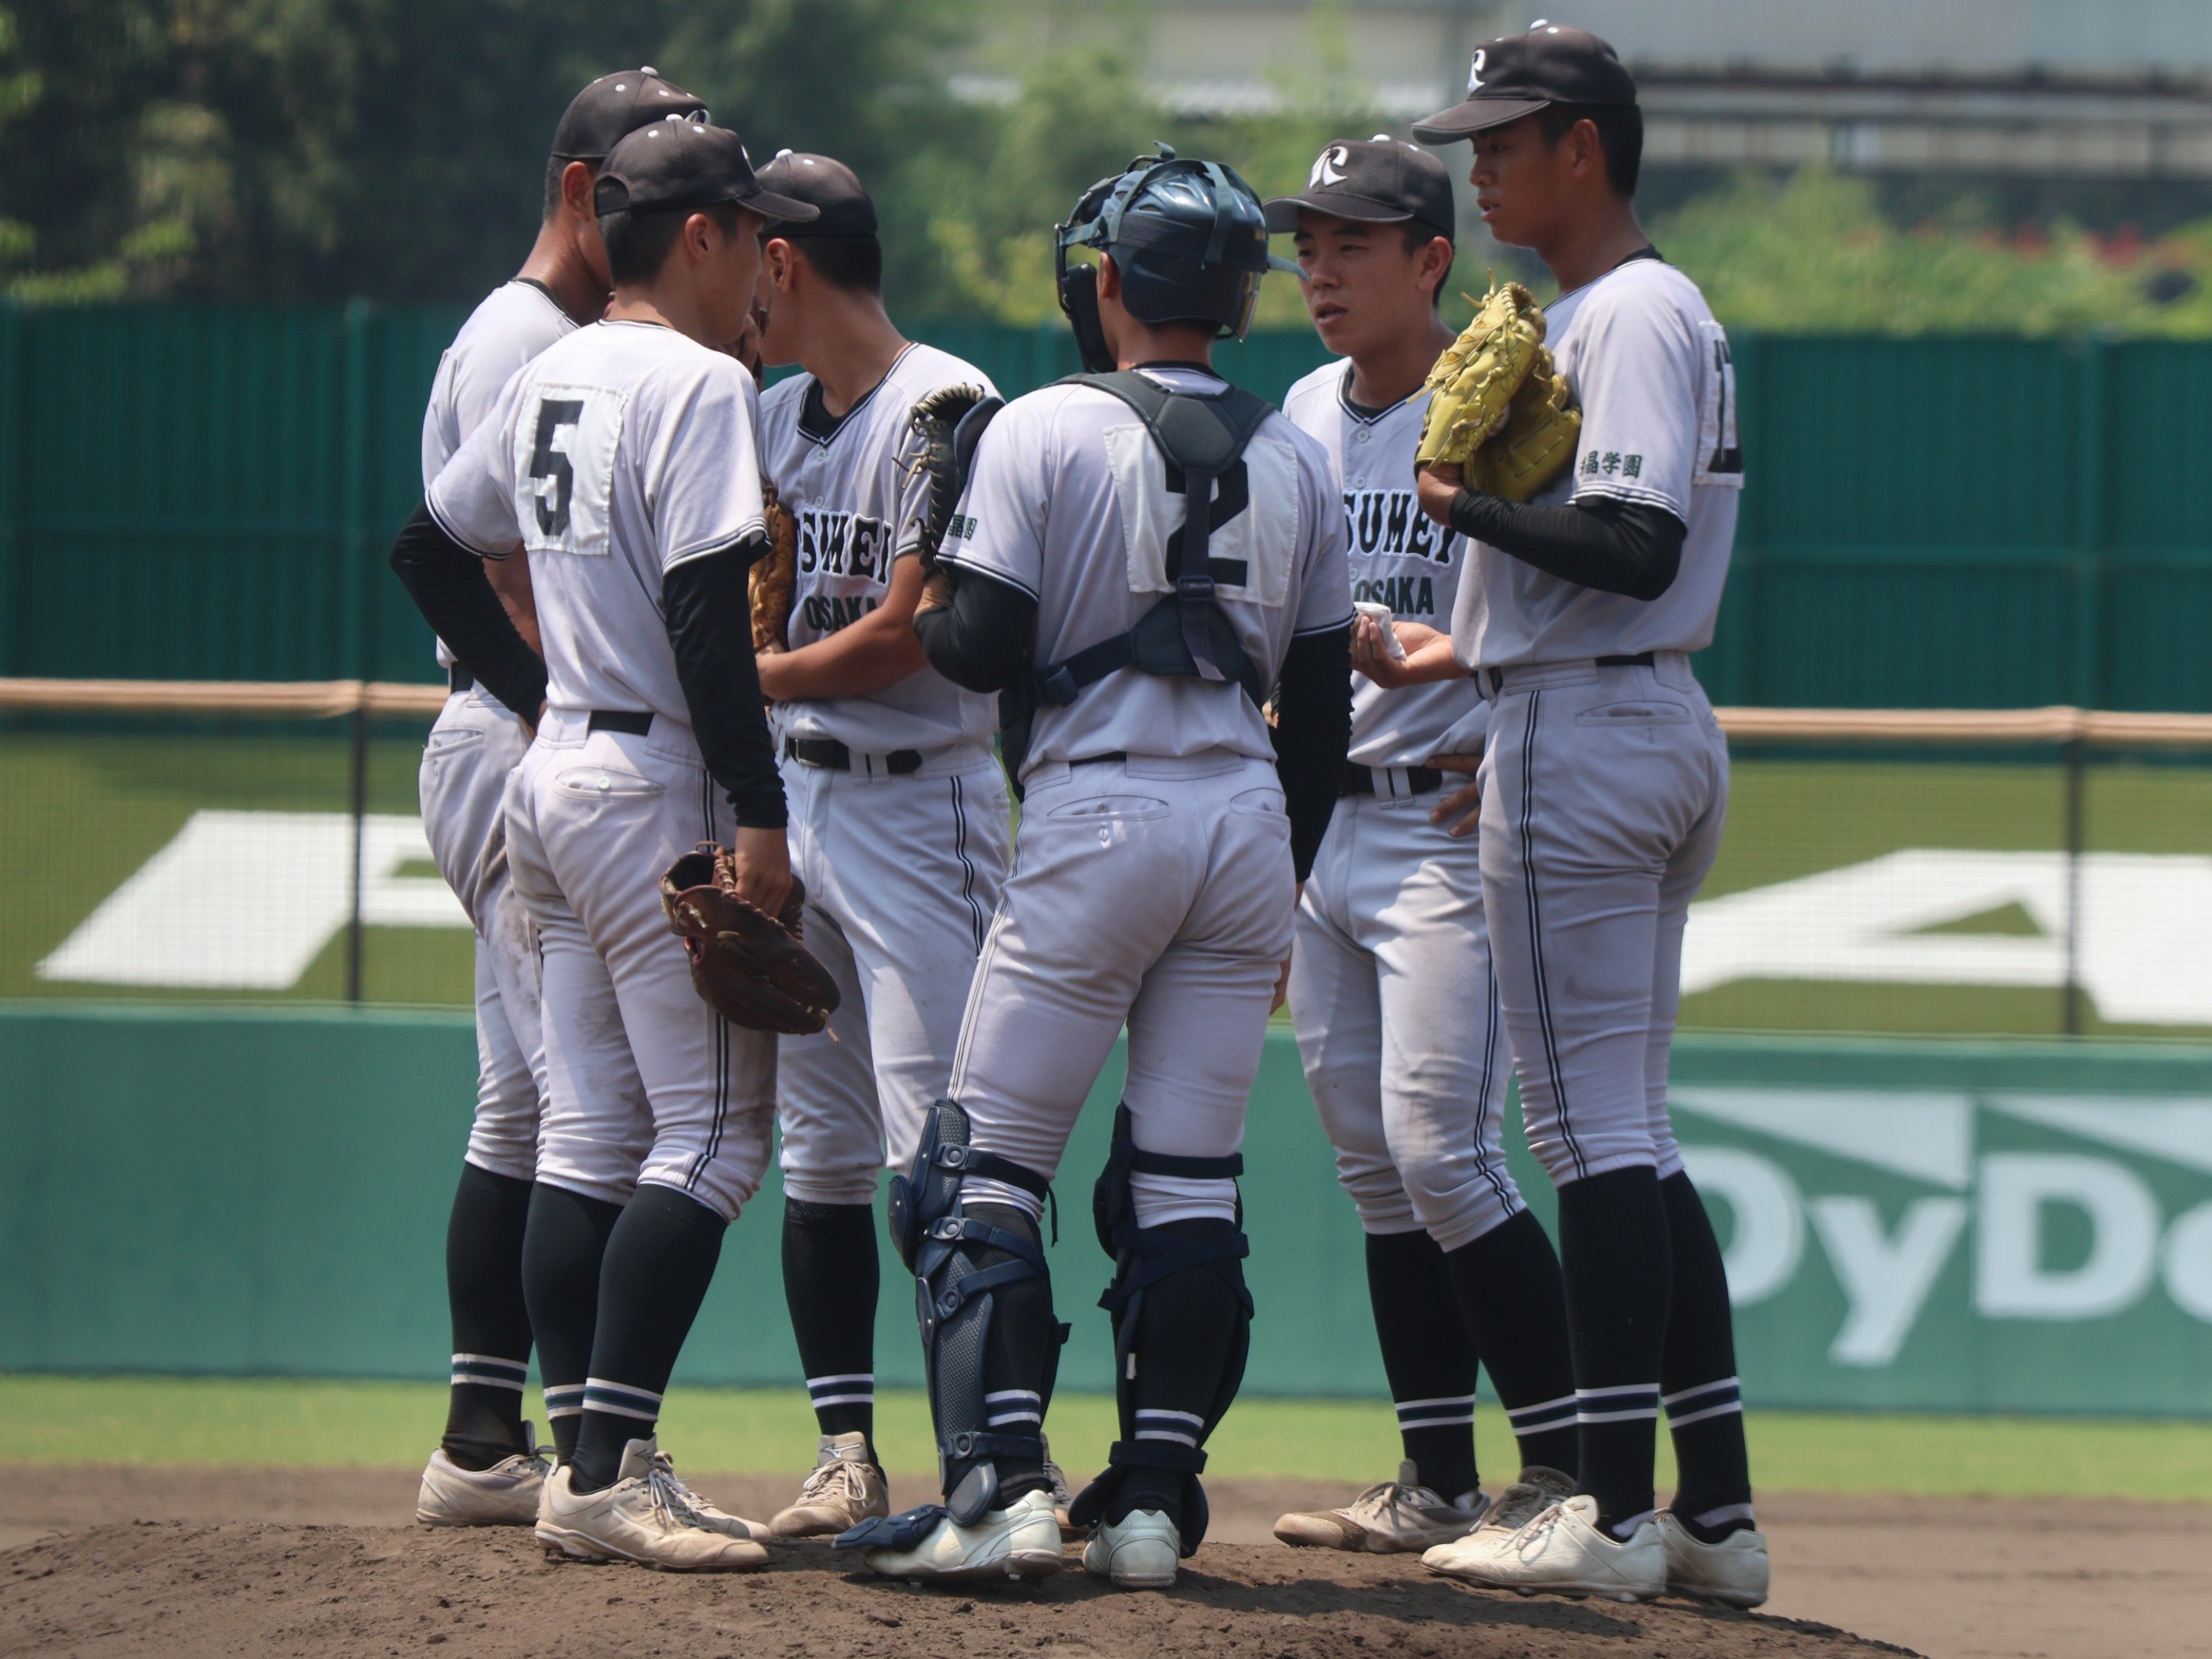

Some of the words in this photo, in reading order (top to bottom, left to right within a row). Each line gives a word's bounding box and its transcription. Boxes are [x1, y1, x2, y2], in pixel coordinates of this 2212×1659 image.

[1309, 146, 1348, 188] R
[529, 398, 585, 536] 5
[1165, 457, 1249, 587] 2
